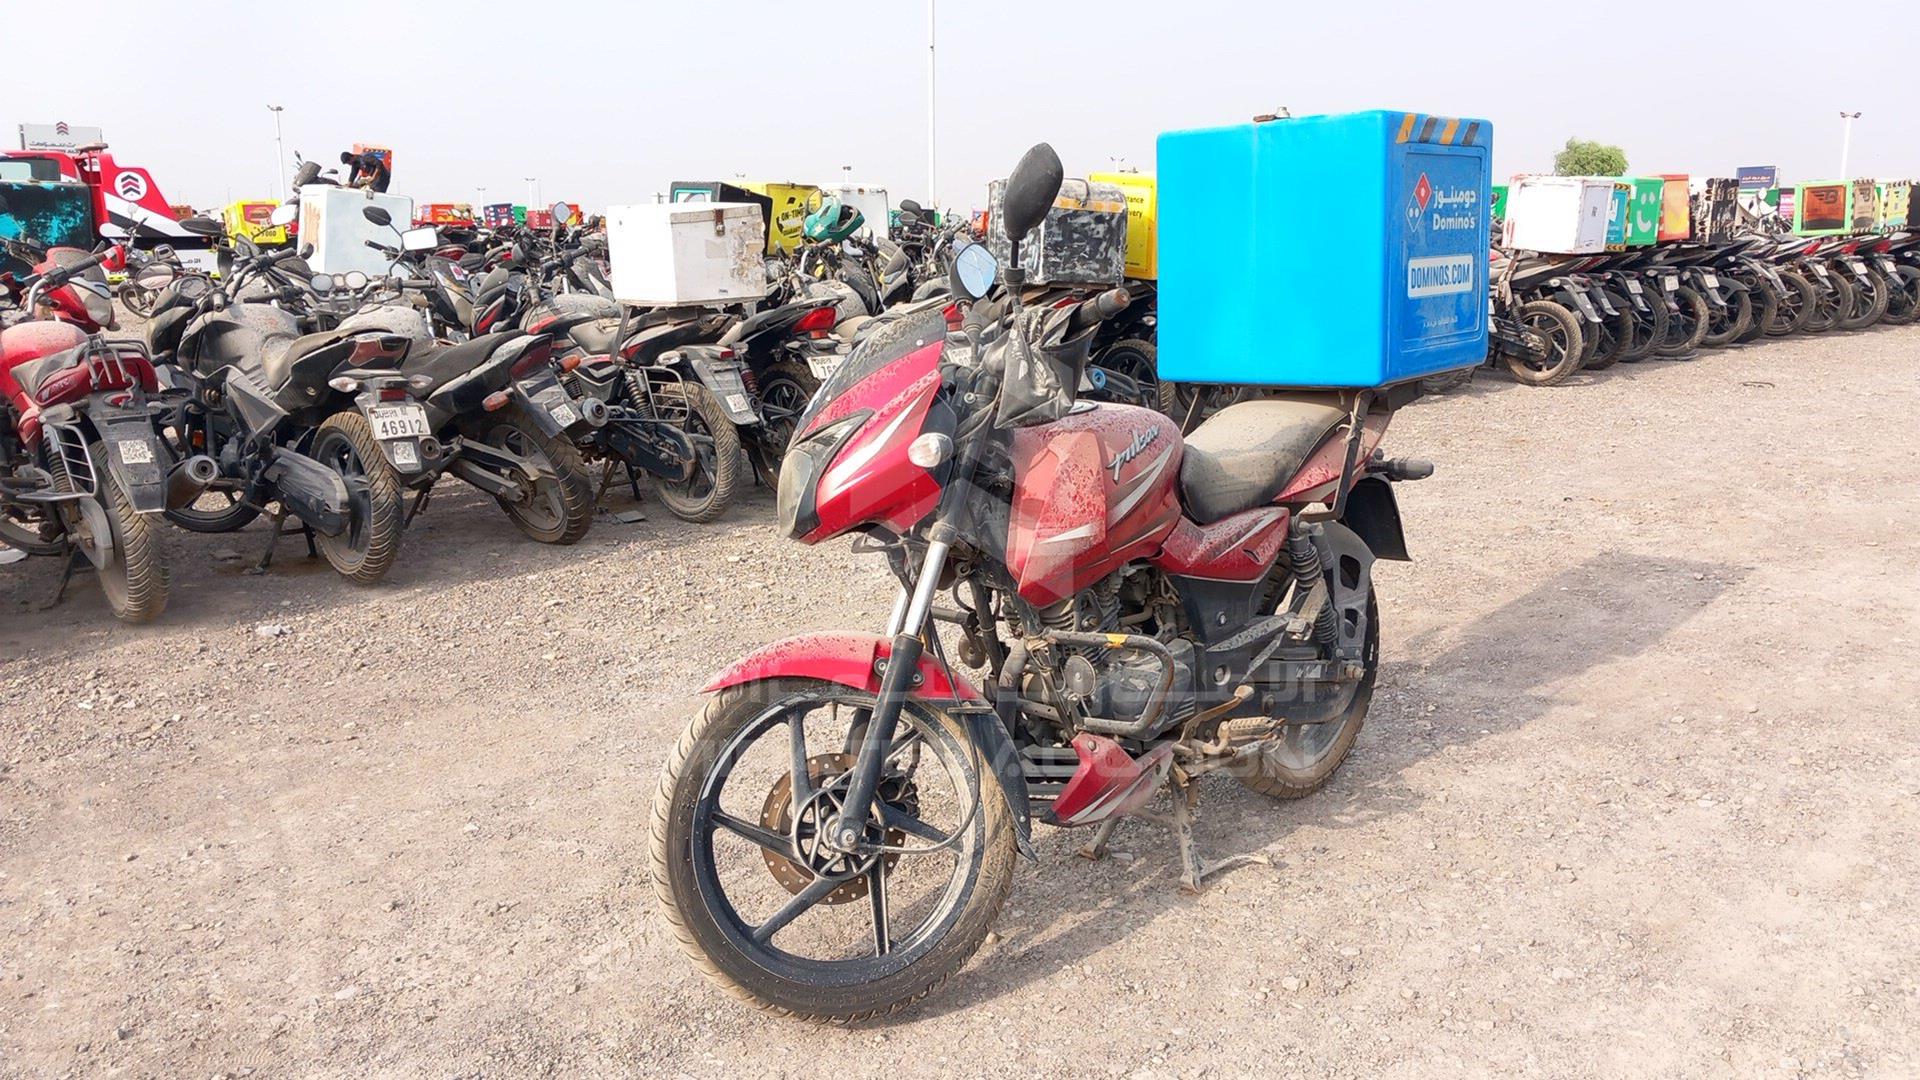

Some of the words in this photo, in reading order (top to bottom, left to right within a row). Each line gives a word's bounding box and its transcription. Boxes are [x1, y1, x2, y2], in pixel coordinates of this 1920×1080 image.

[1433, 212, 1476, 231] Domino's
[1411, 263, 1470, 289] DOMINOS.COM
[381, 419, 423, 436] 46912
